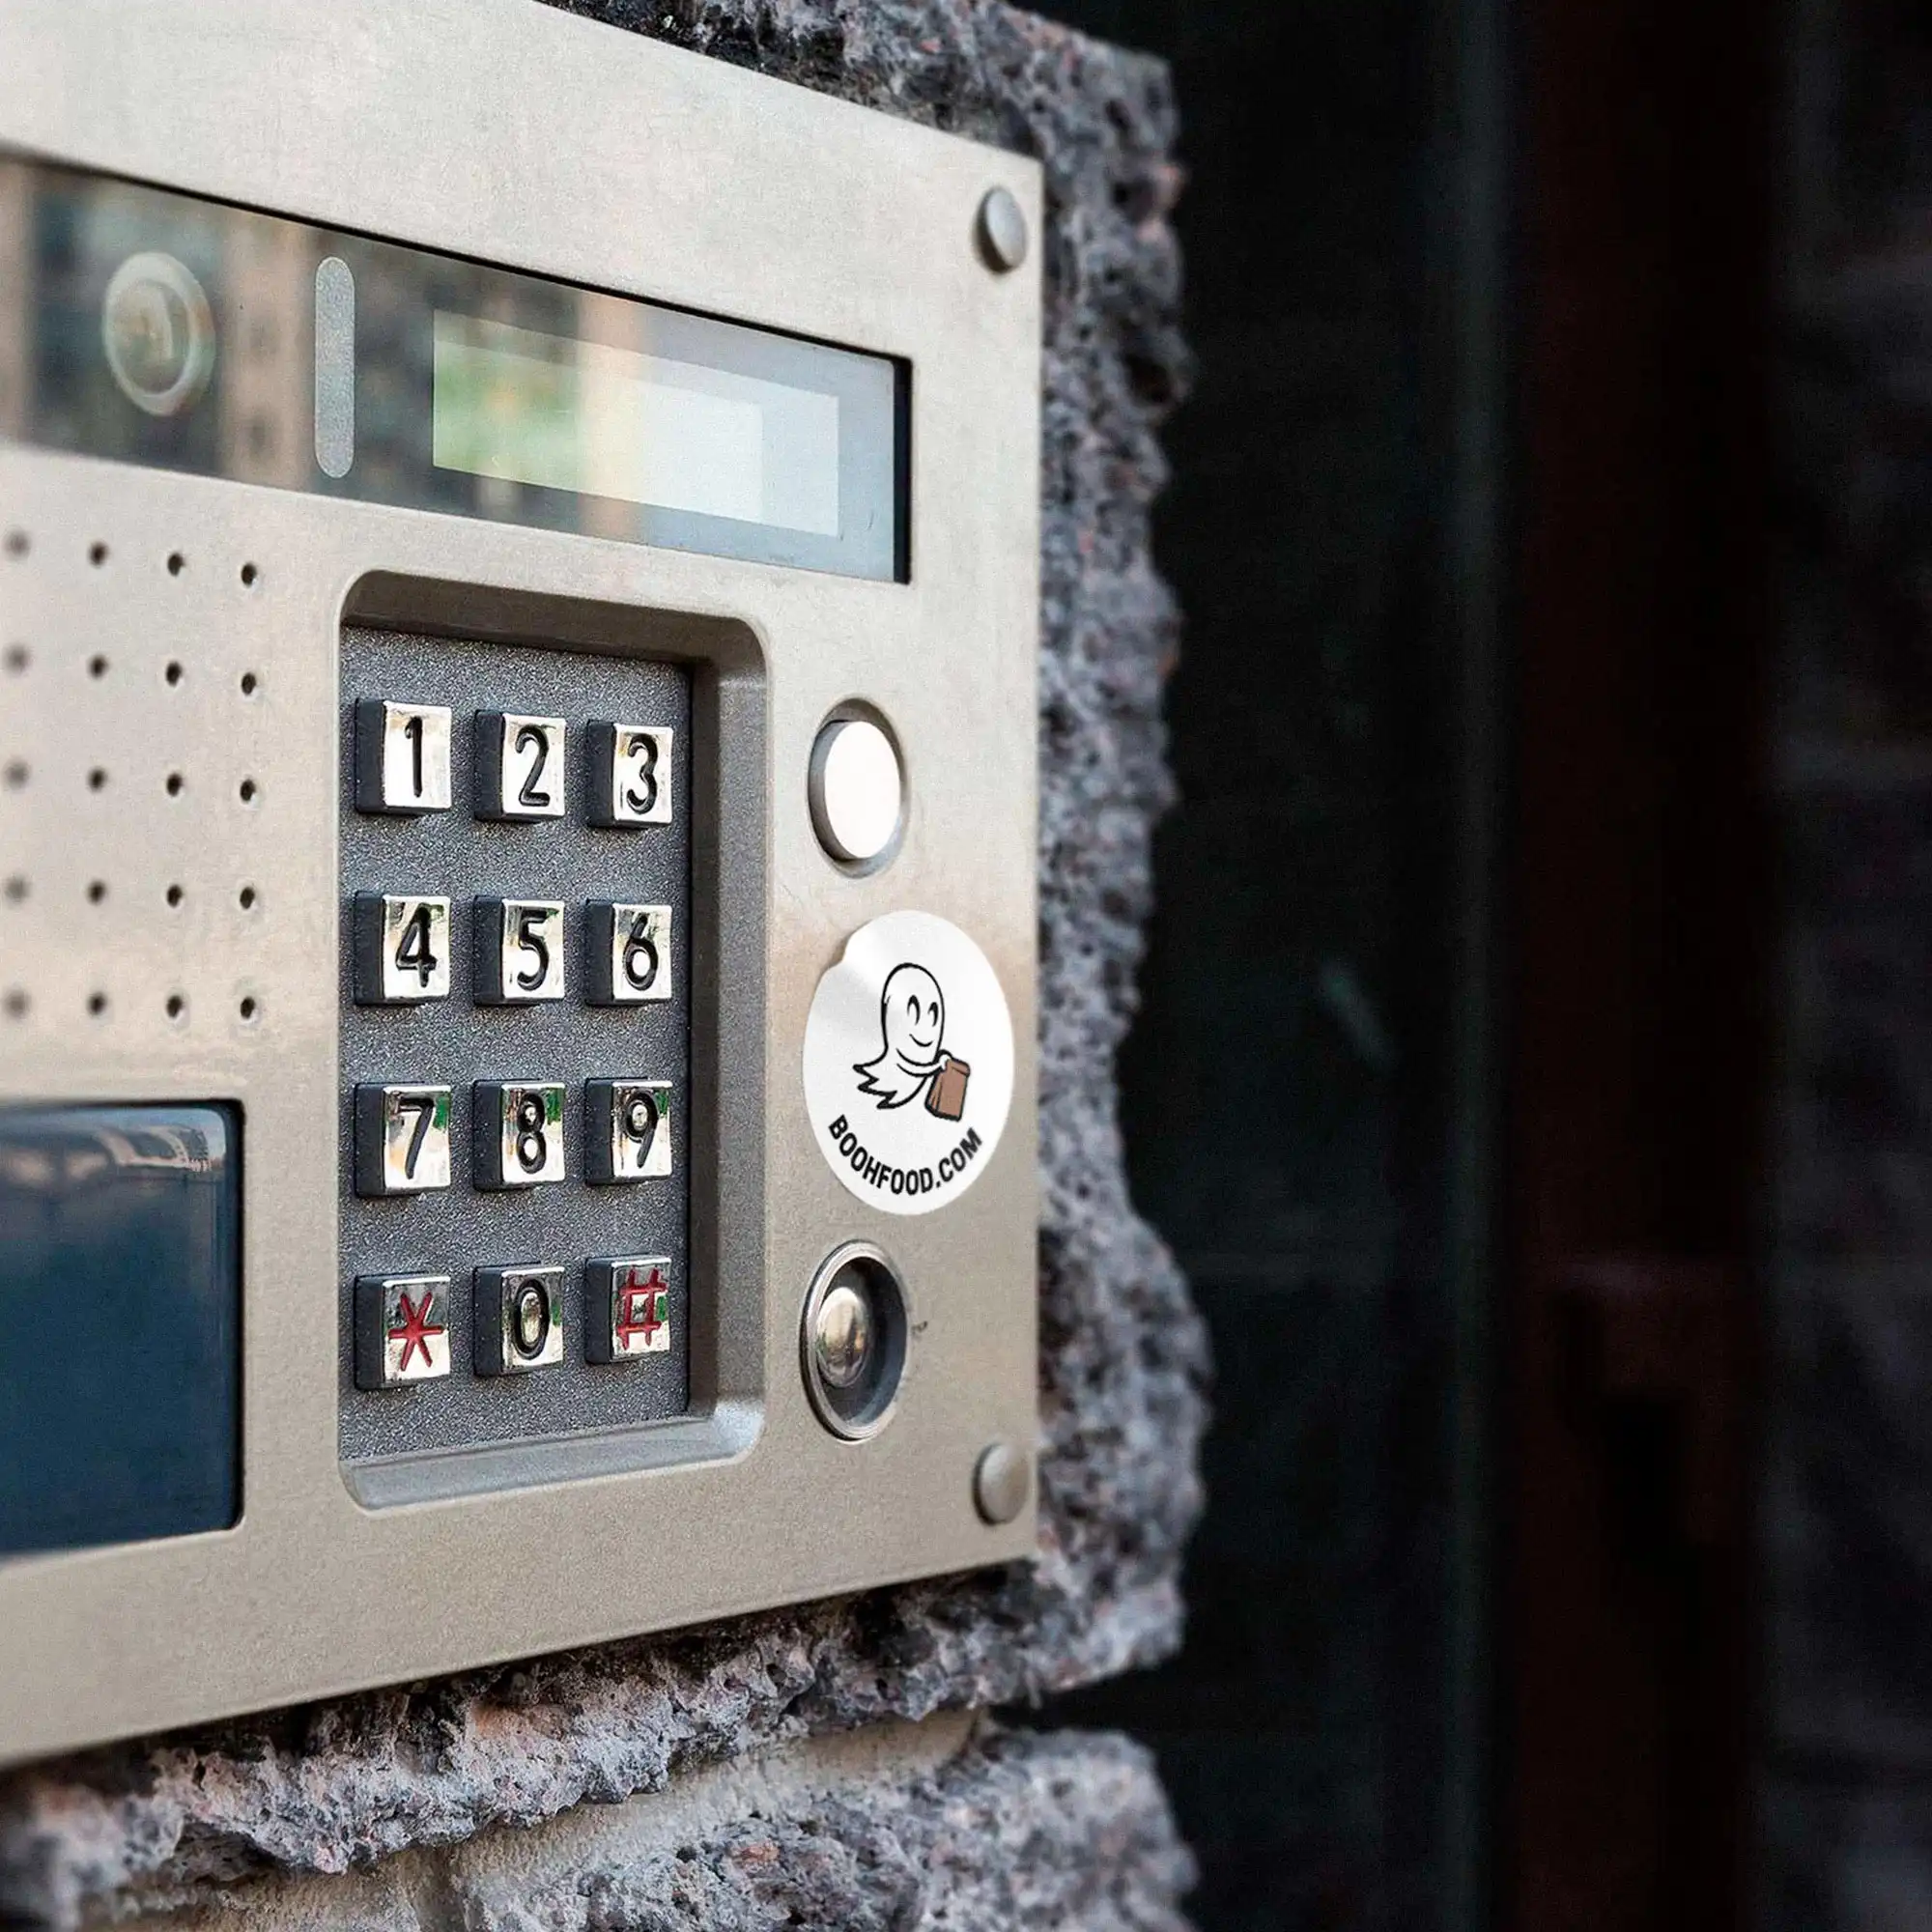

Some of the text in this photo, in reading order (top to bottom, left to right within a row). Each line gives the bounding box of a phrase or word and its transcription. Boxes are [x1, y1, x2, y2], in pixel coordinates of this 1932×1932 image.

[404, 716, 658, 815] 1 2 3
[395, 904, 659, 991] 4 5 6
[398, 1091, 659, 1179] 7 8 9
[828, 1114, 983, 1196] BOOHFOOD.COM
[513, 1278, 552, 1360] 0
